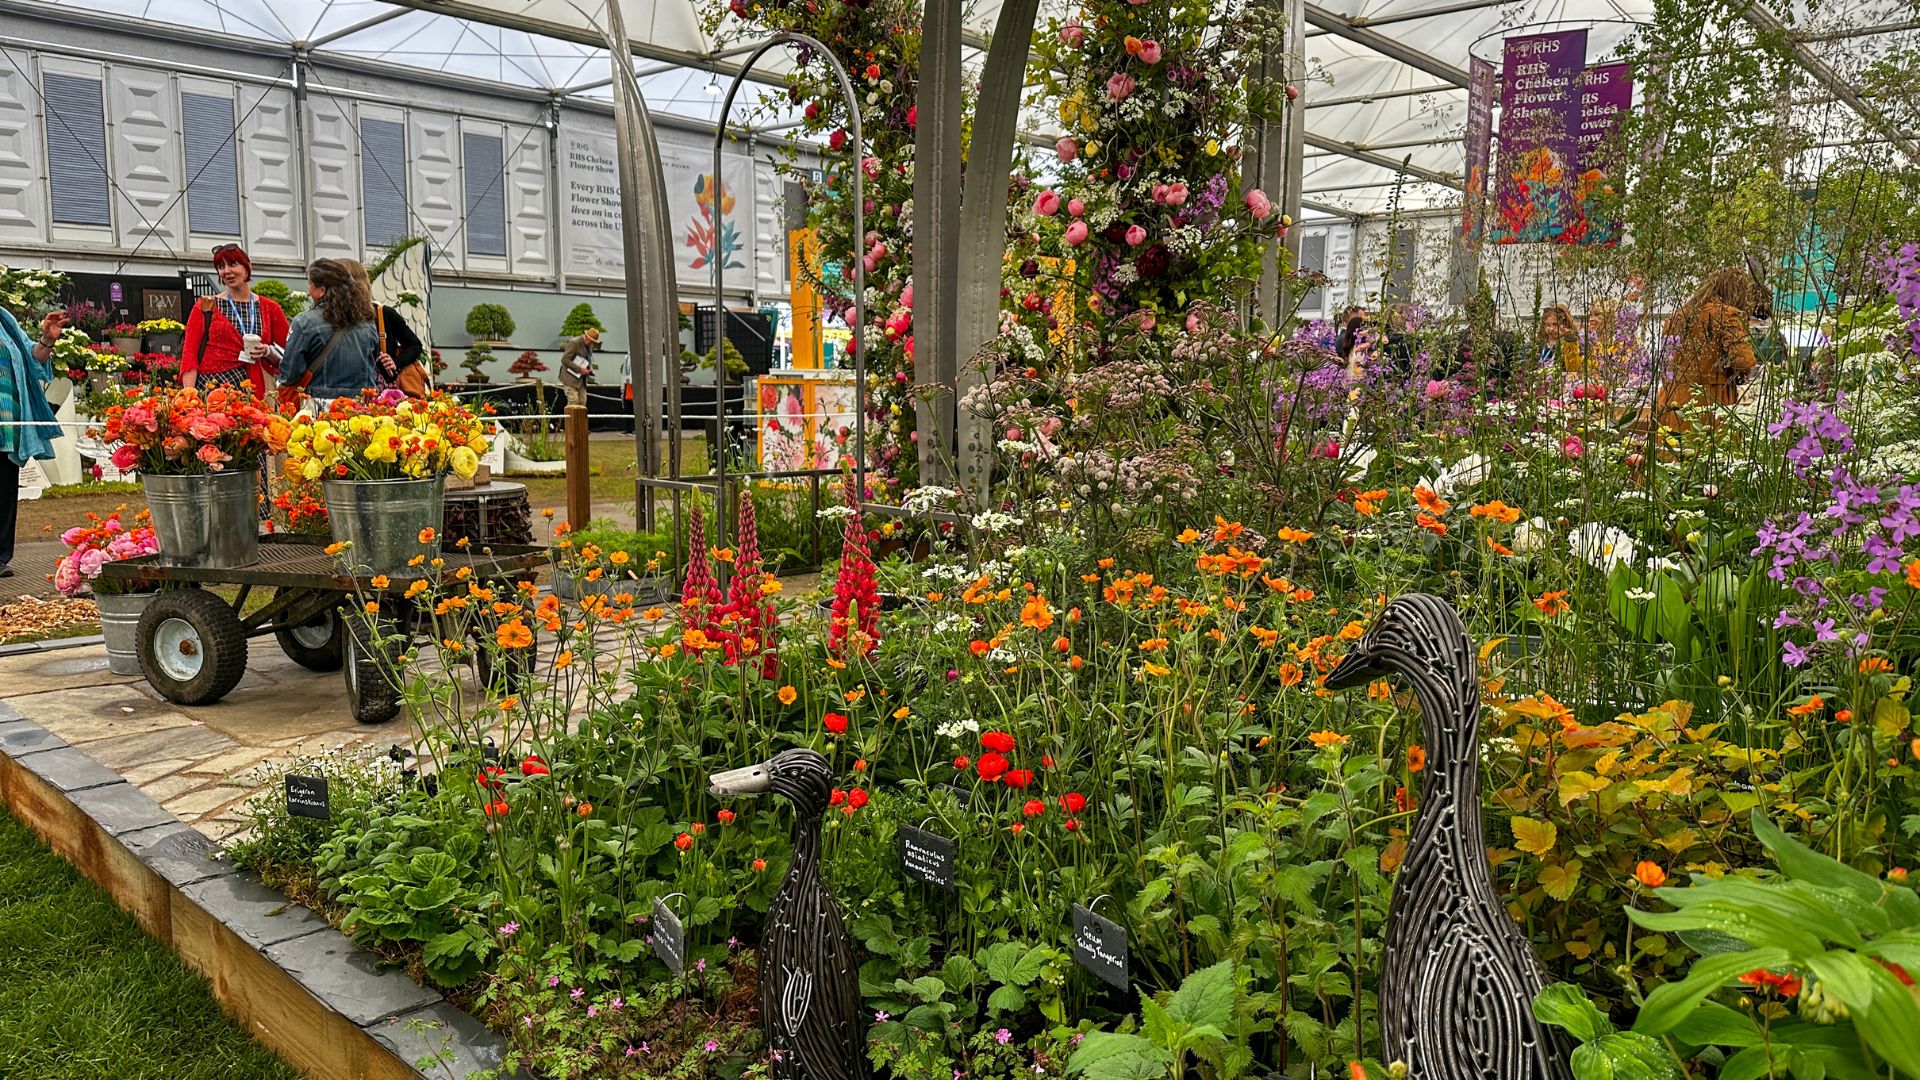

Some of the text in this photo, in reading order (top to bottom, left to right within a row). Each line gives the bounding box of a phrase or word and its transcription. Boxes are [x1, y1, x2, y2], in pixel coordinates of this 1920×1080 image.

[1533, 40, 1560, 54] RHS
[1515, 62, 1548, 76] RHS
[1515, 76, 1568, 90] Chelsea
[1585, 72, 1610, 85] RHS
[1514, 92, 1562, 104] Flower
[1581, 92, 1599, 104] HS
[1581, 105, 1618, 117] elsea
[1581, 119, 1613, 130] ower
[576, 142, 589, 151] RHS
[570, 152, 613, 166] RHS Chelsea
[570, 161, 615, 174] Flower Show
[571, 181, 595, 194] Every
[596, 184, 615, 195] RHS
[571, 193, 599, 205] Flower
[571, 205, 590, 215] lives
[591, 209, 602, 217] on
[604, 209, 613, 218] in
[572, 219, 598, 228] across
[599, 220, 614, 230] the
[1083, 926, 1103, 946] Geum
